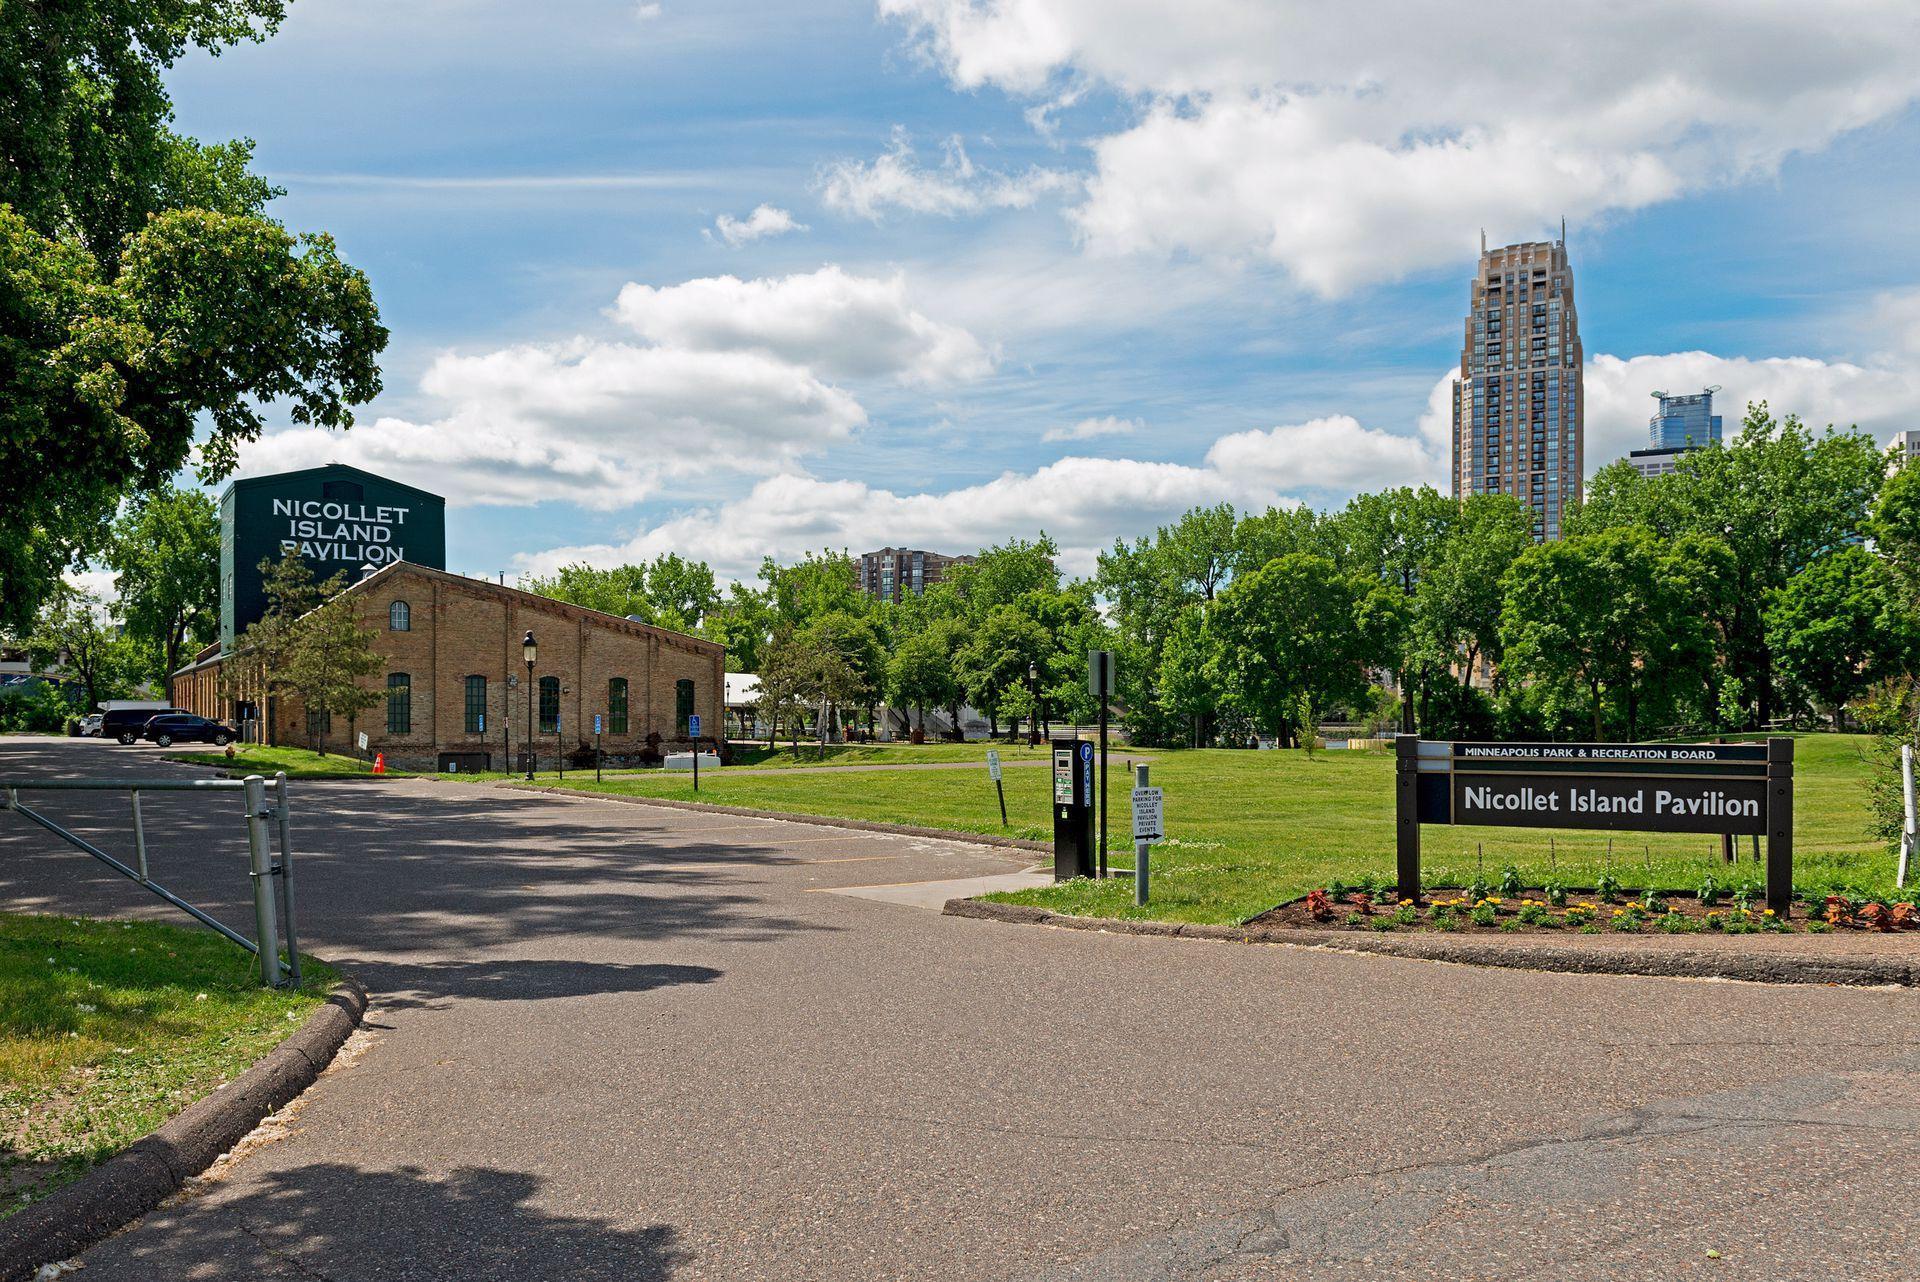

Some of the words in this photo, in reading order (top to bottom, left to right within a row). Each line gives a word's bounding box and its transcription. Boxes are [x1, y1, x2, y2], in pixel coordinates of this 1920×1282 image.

[273, 498, 409, 524] NICOLLET
[290, 520, 391, 542] ISLAND
[281, 540, 404, 562] PAVILION
[1084, 746, 1090, 759] P
[1465, 747, 1540, 757] MINNEAPOLIS
[1543, 748, 1574, 758] PARK
[1578, 748, 1586, 758] &
[1592, 748, 1668, 759] RECREATION
[1671, 750, 1714, 760] BOARD
[1464, 786, 1560, 812] Nicollet
[1570, 788, 1643, 814] Island
[1656, 790, 1759, 817] Pavilion
